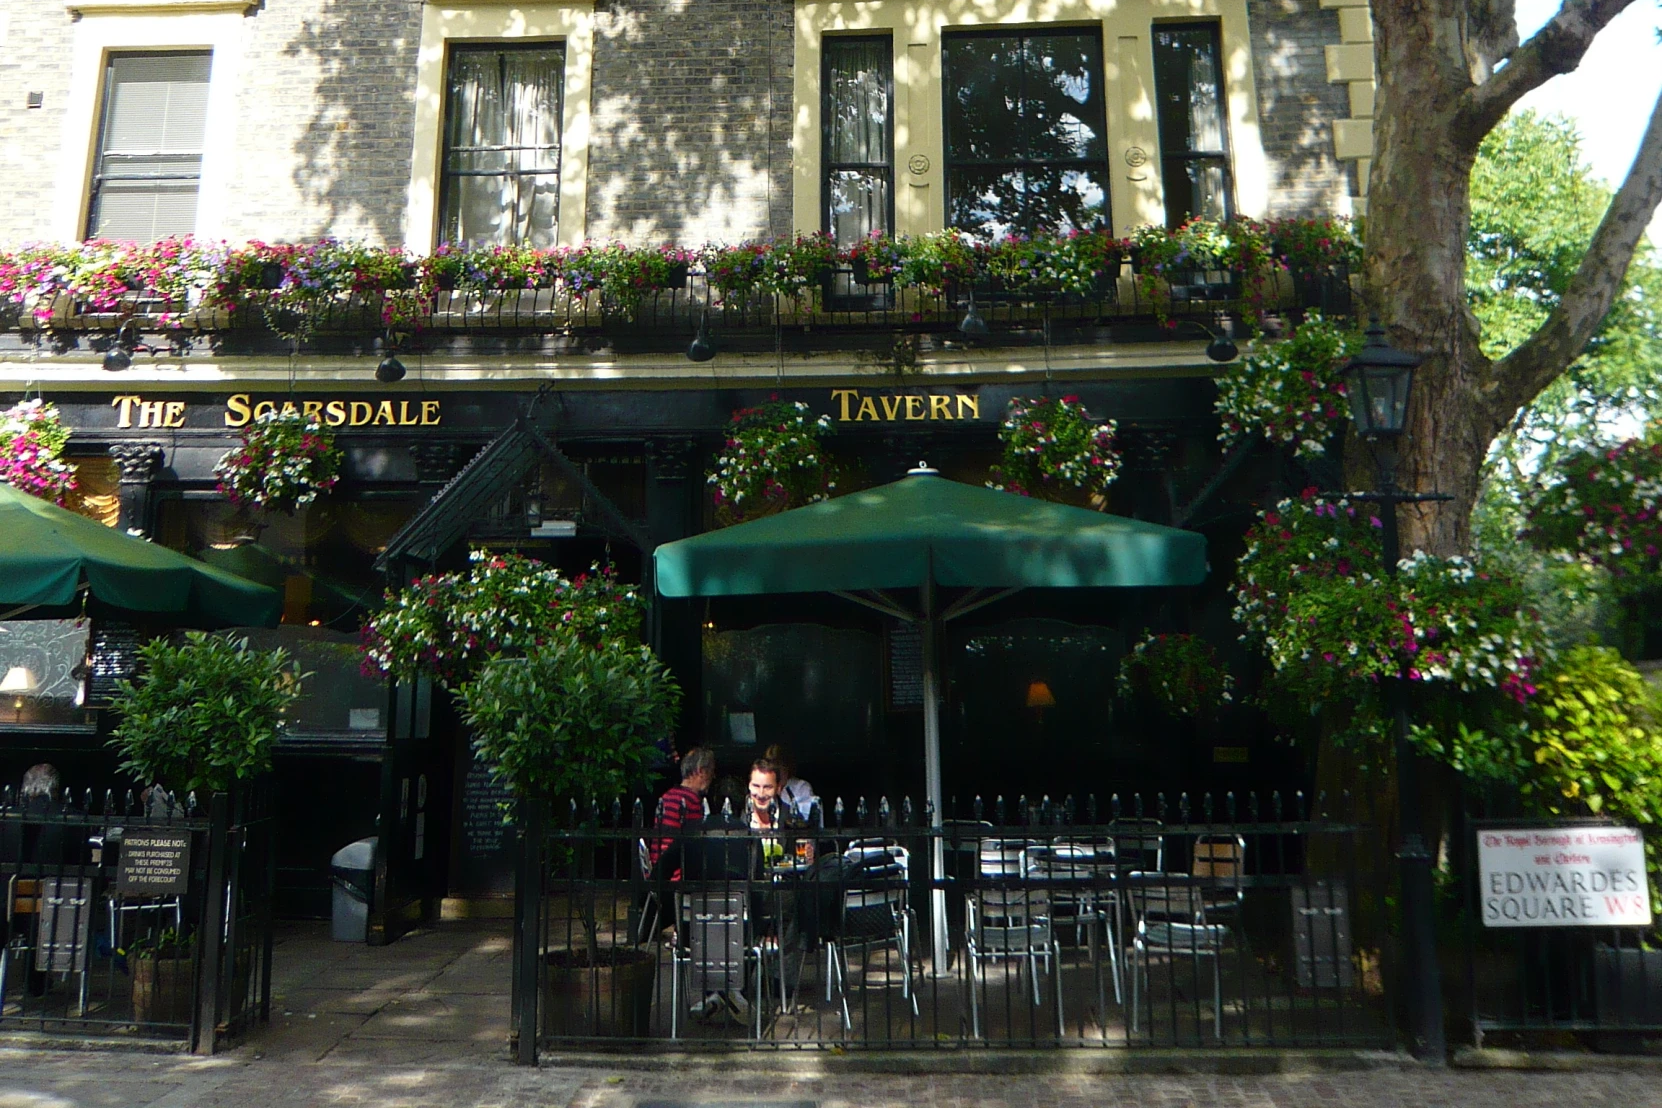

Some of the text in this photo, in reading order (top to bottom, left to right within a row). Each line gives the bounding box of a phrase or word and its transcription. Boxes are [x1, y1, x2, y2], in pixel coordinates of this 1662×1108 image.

[111, 394, 186, 428] THE
[831, 389, 980, 421] TAVERN
[124, 838, 149, 846] PATRONS
[150, 839, 171, 847] PLEASE
[1490, 870, 1638, 894] EDWARDES
[1487, 895, 1645, 921] SQUARE W8
